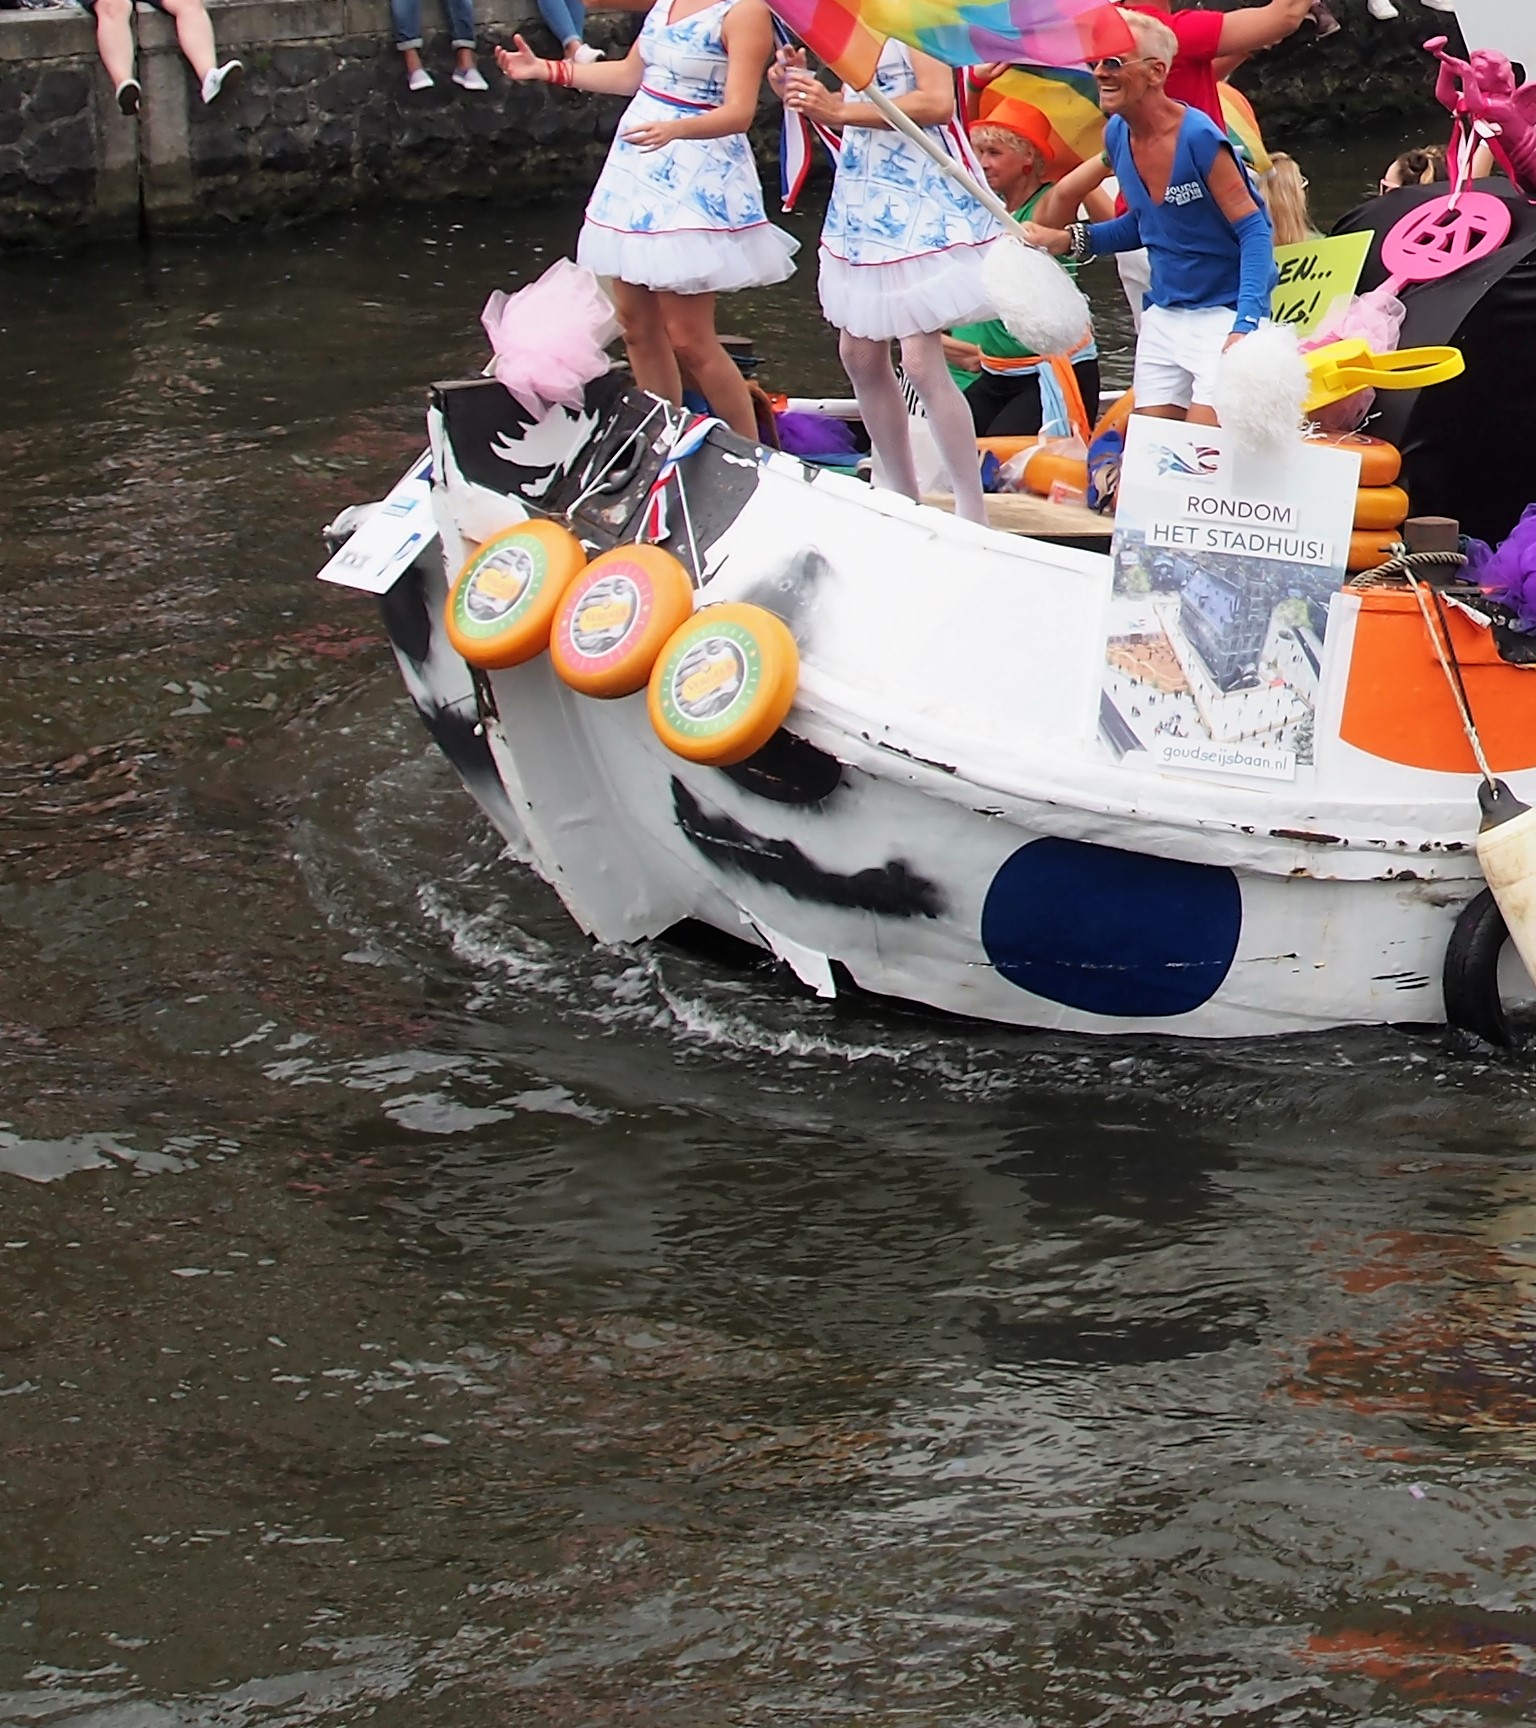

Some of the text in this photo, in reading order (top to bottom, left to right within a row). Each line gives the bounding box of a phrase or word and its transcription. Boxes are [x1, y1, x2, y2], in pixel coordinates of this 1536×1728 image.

[1276, 255, 1333, 286] EN...
[1187, 496, 1291, 523] RONDOM
[1153, 524, 1324, 560] HET STADHUIS!
[1163, 743, 1288, 771] goudseijsbaan.nl
